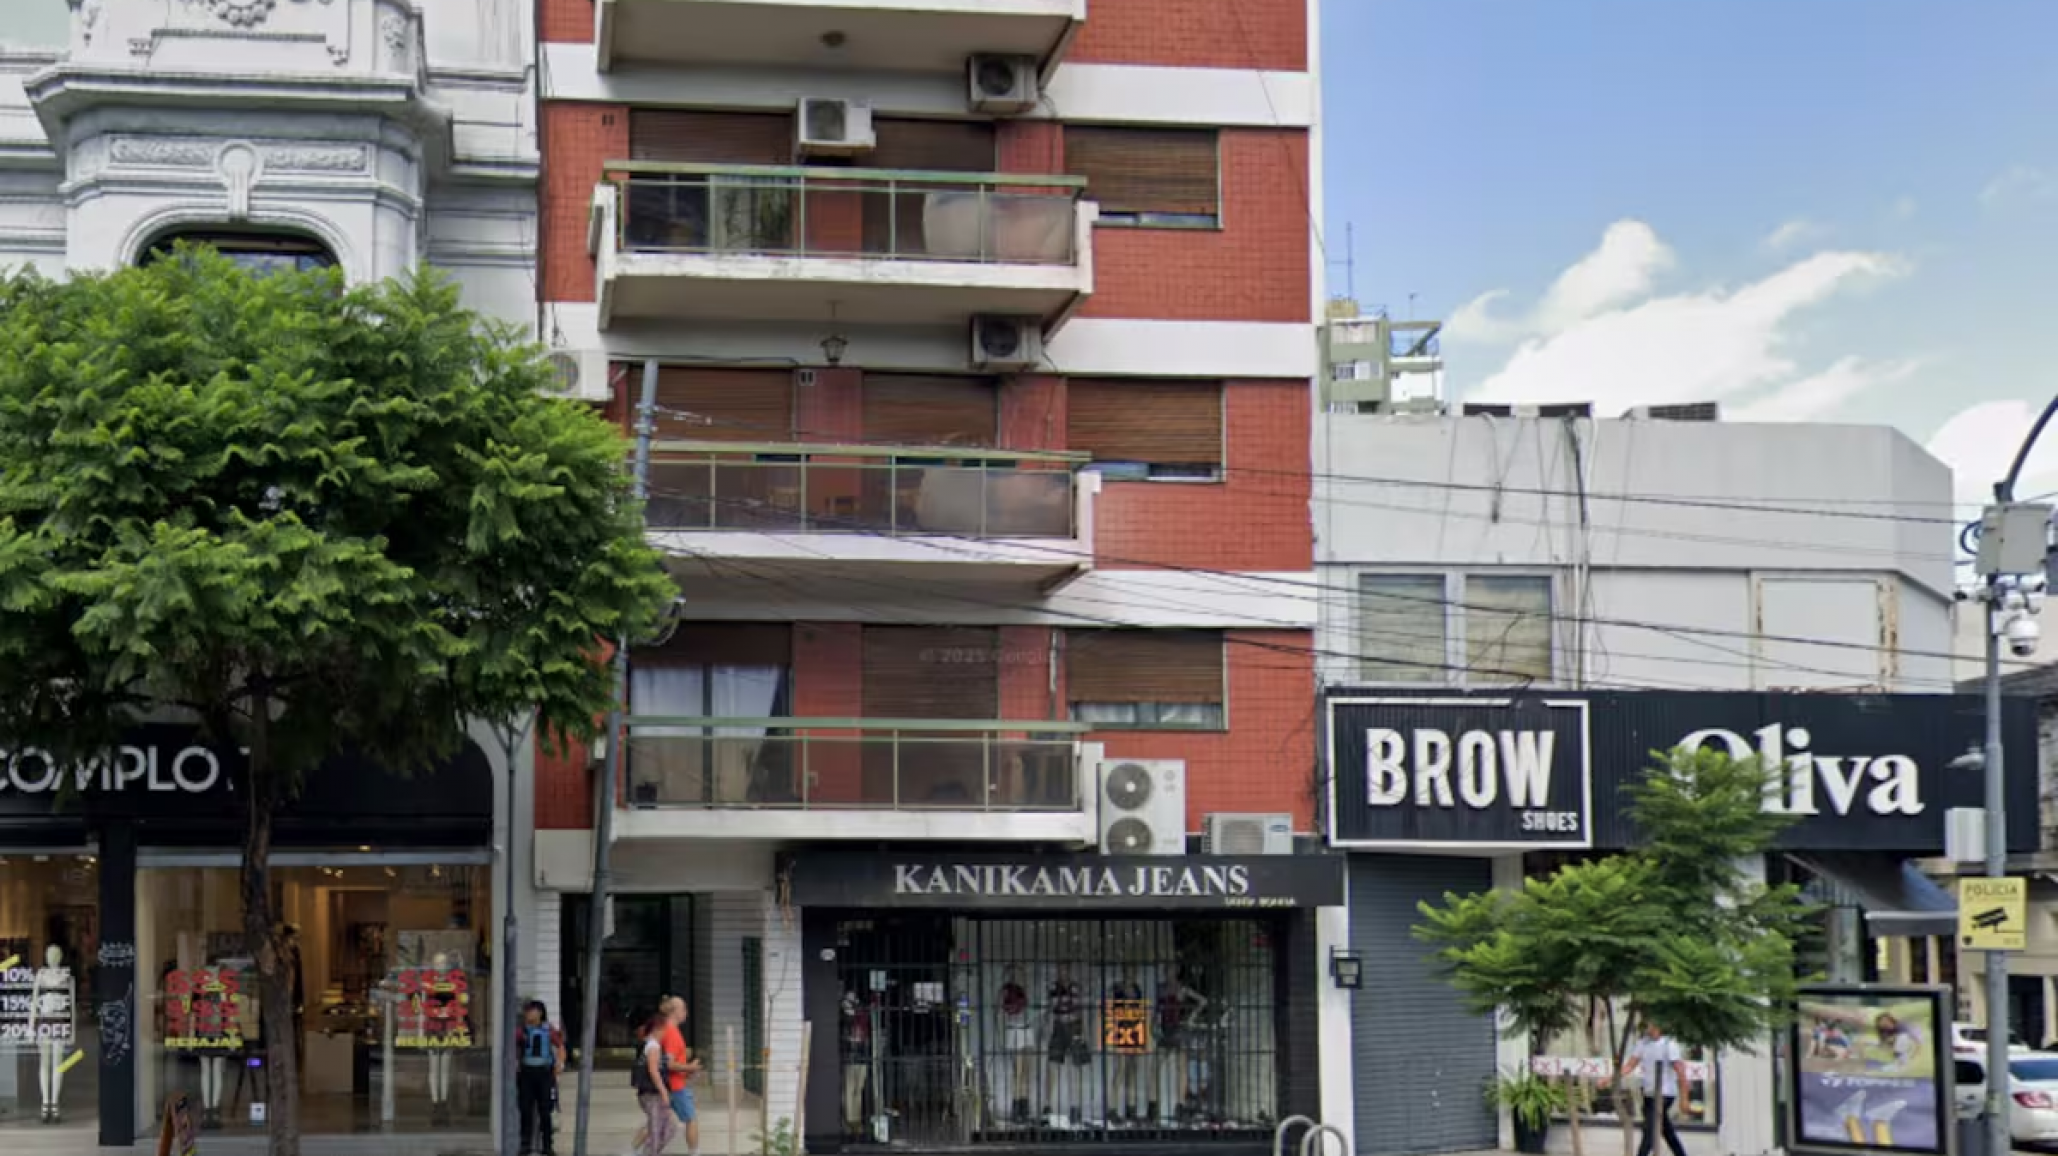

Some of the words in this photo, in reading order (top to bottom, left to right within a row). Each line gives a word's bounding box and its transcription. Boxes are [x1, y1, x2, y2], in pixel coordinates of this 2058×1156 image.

[0, 746, 250, 792] OMPLO
[1366, 728, 1555, 808] BROW
[1522, 811, 1579, 831] SHOES
[894, 864, 1121, 896] KANIKAMA
[1127, 864, 1250, 897] JEANS
